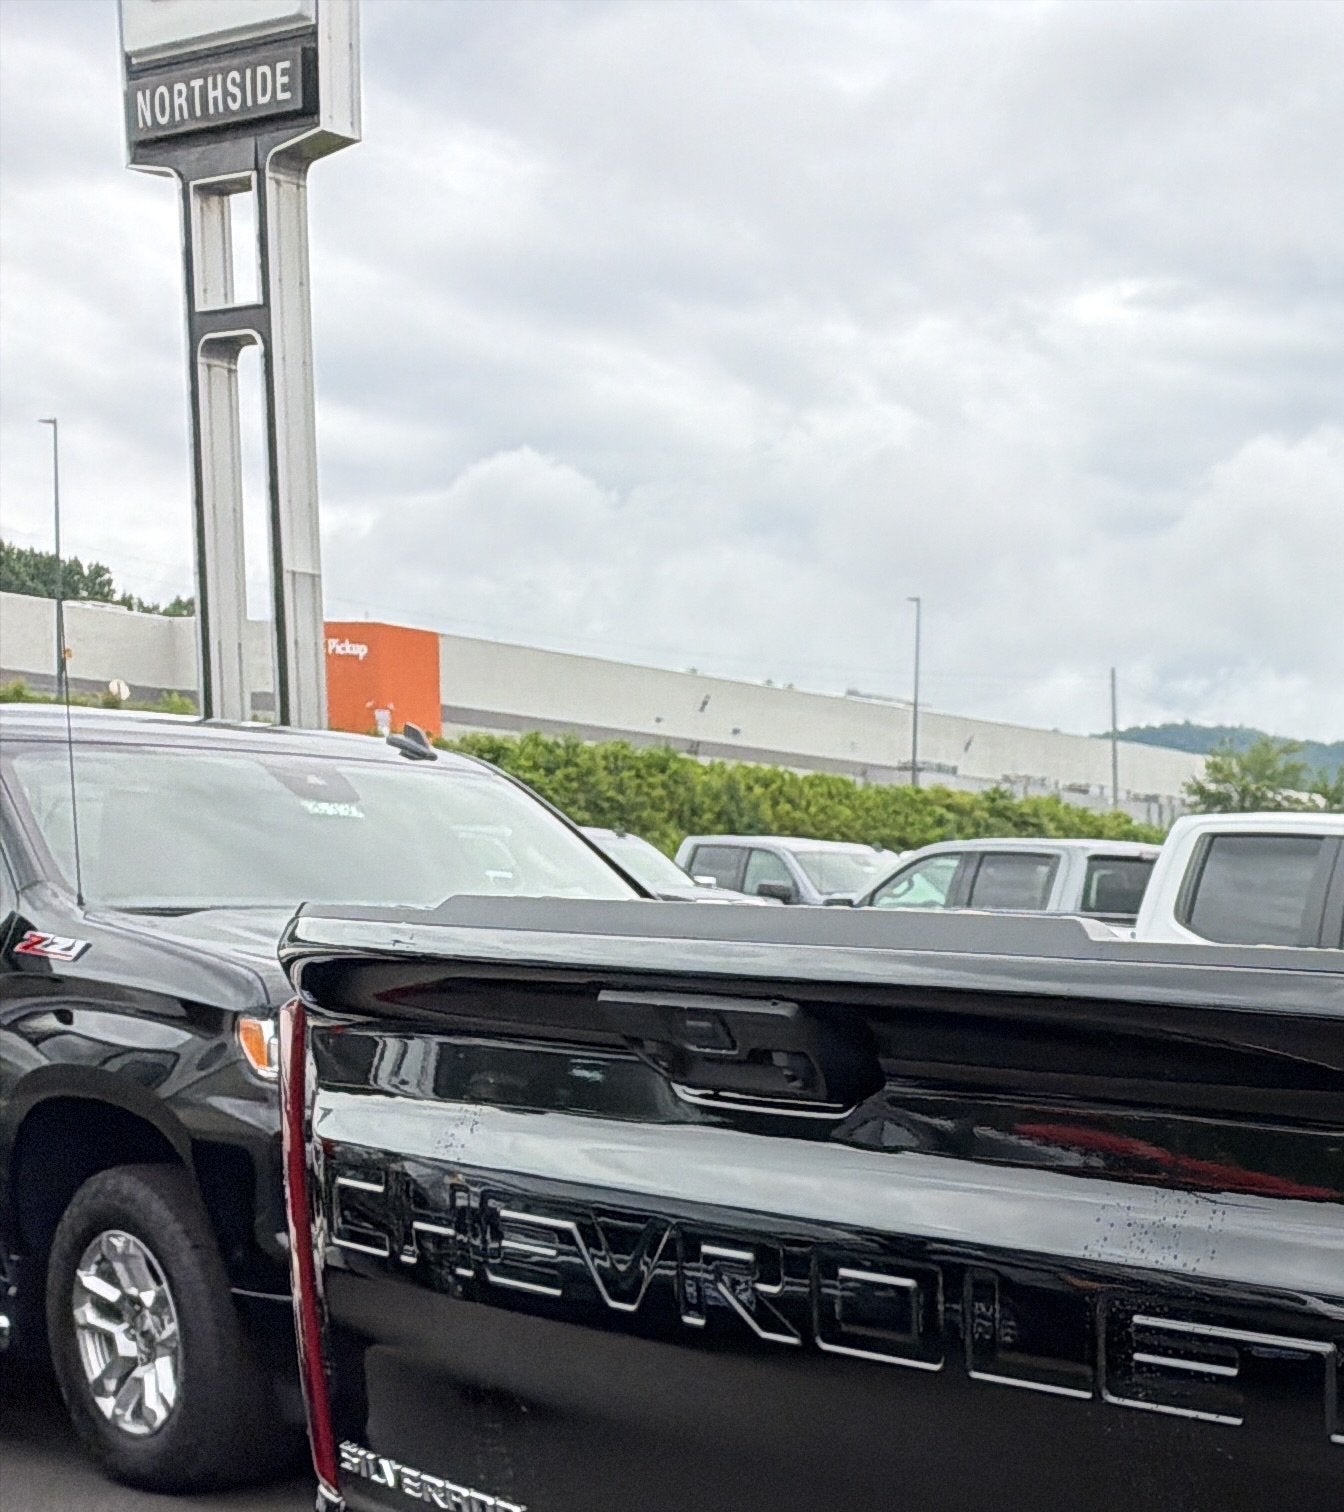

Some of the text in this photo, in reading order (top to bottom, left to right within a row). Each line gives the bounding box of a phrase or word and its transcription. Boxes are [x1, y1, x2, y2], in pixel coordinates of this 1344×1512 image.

[137, 60, 291, 129] NORTHSIDE
[327, 638, 369, 661] Pickup
[13, 930, 89, 962] Z71
